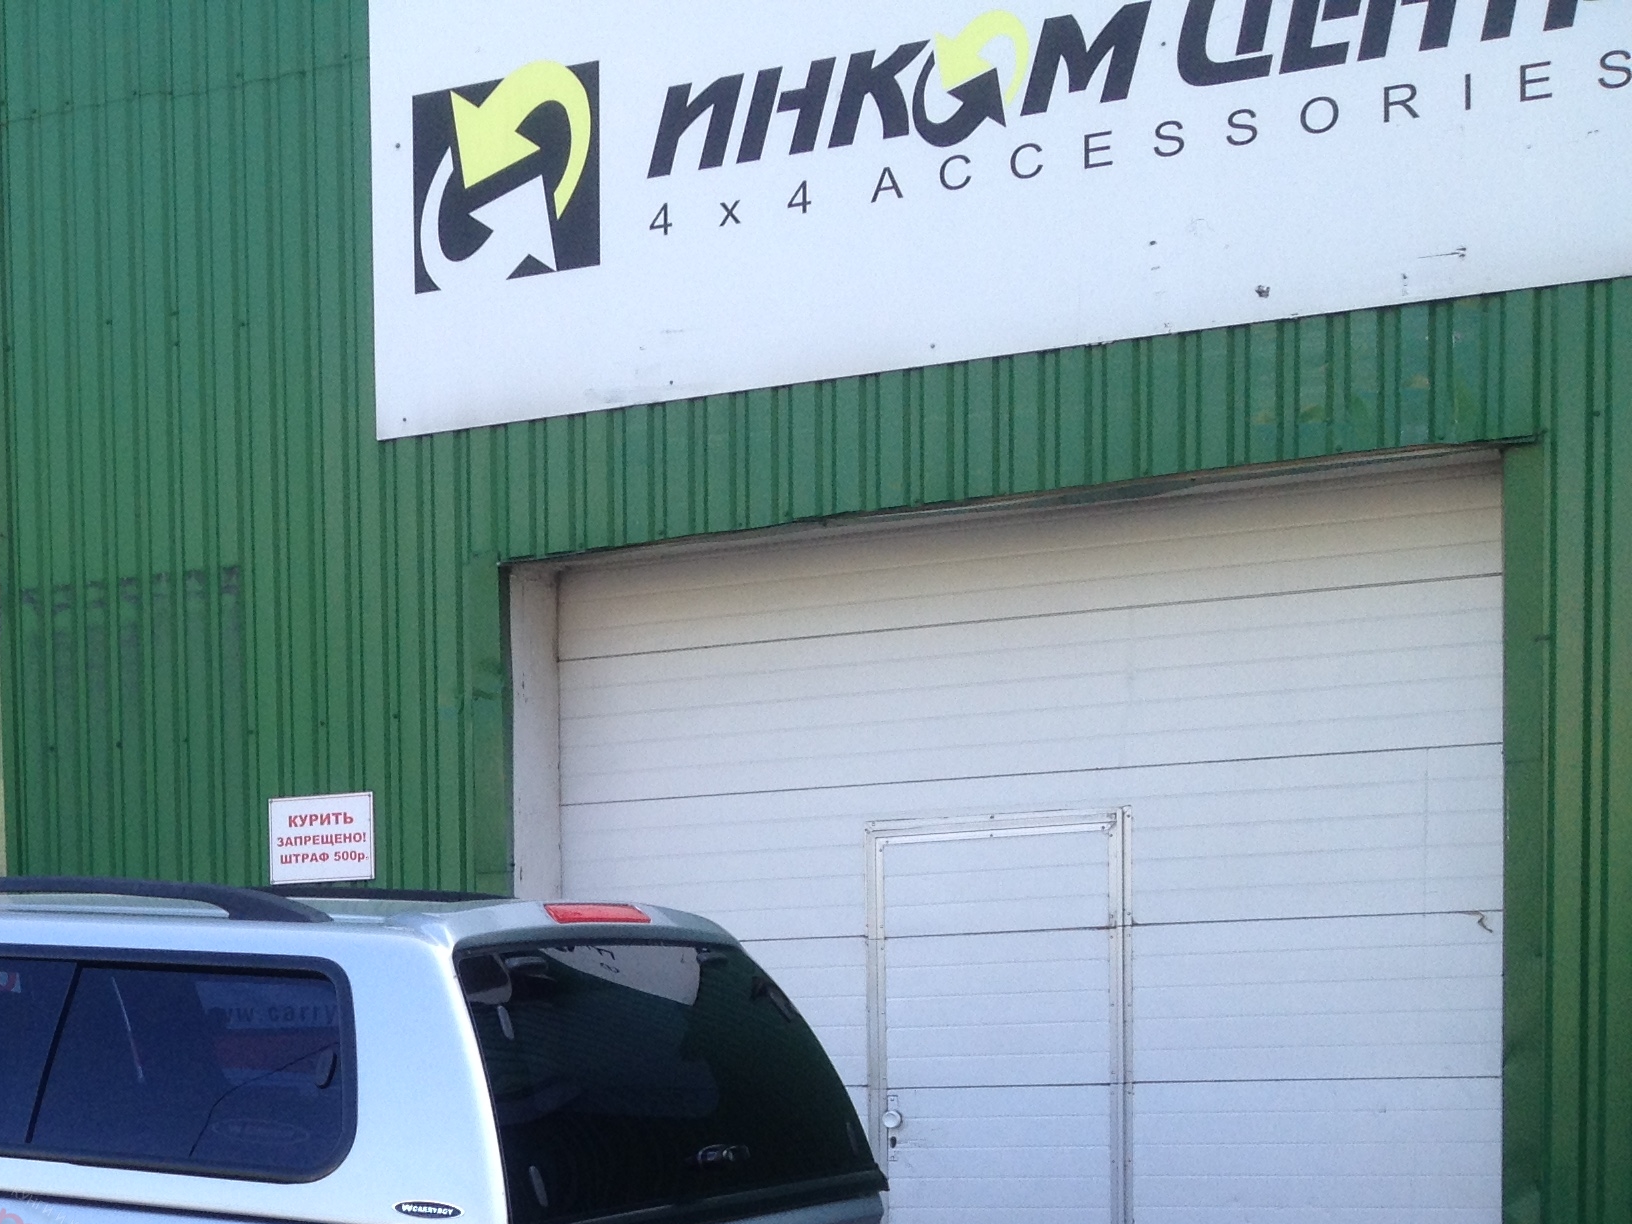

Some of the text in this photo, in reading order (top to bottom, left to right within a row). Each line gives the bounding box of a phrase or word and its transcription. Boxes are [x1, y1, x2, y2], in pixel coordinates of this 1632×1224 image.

[870, 50, 1632, 204] ACCESSORIES
[288, 812, 354, 828] КУРИТЬ
[277, 832, 366, 847] ЗАПРЕЩЕНО!
[280, 852, 329, 864] ШТРАФ
